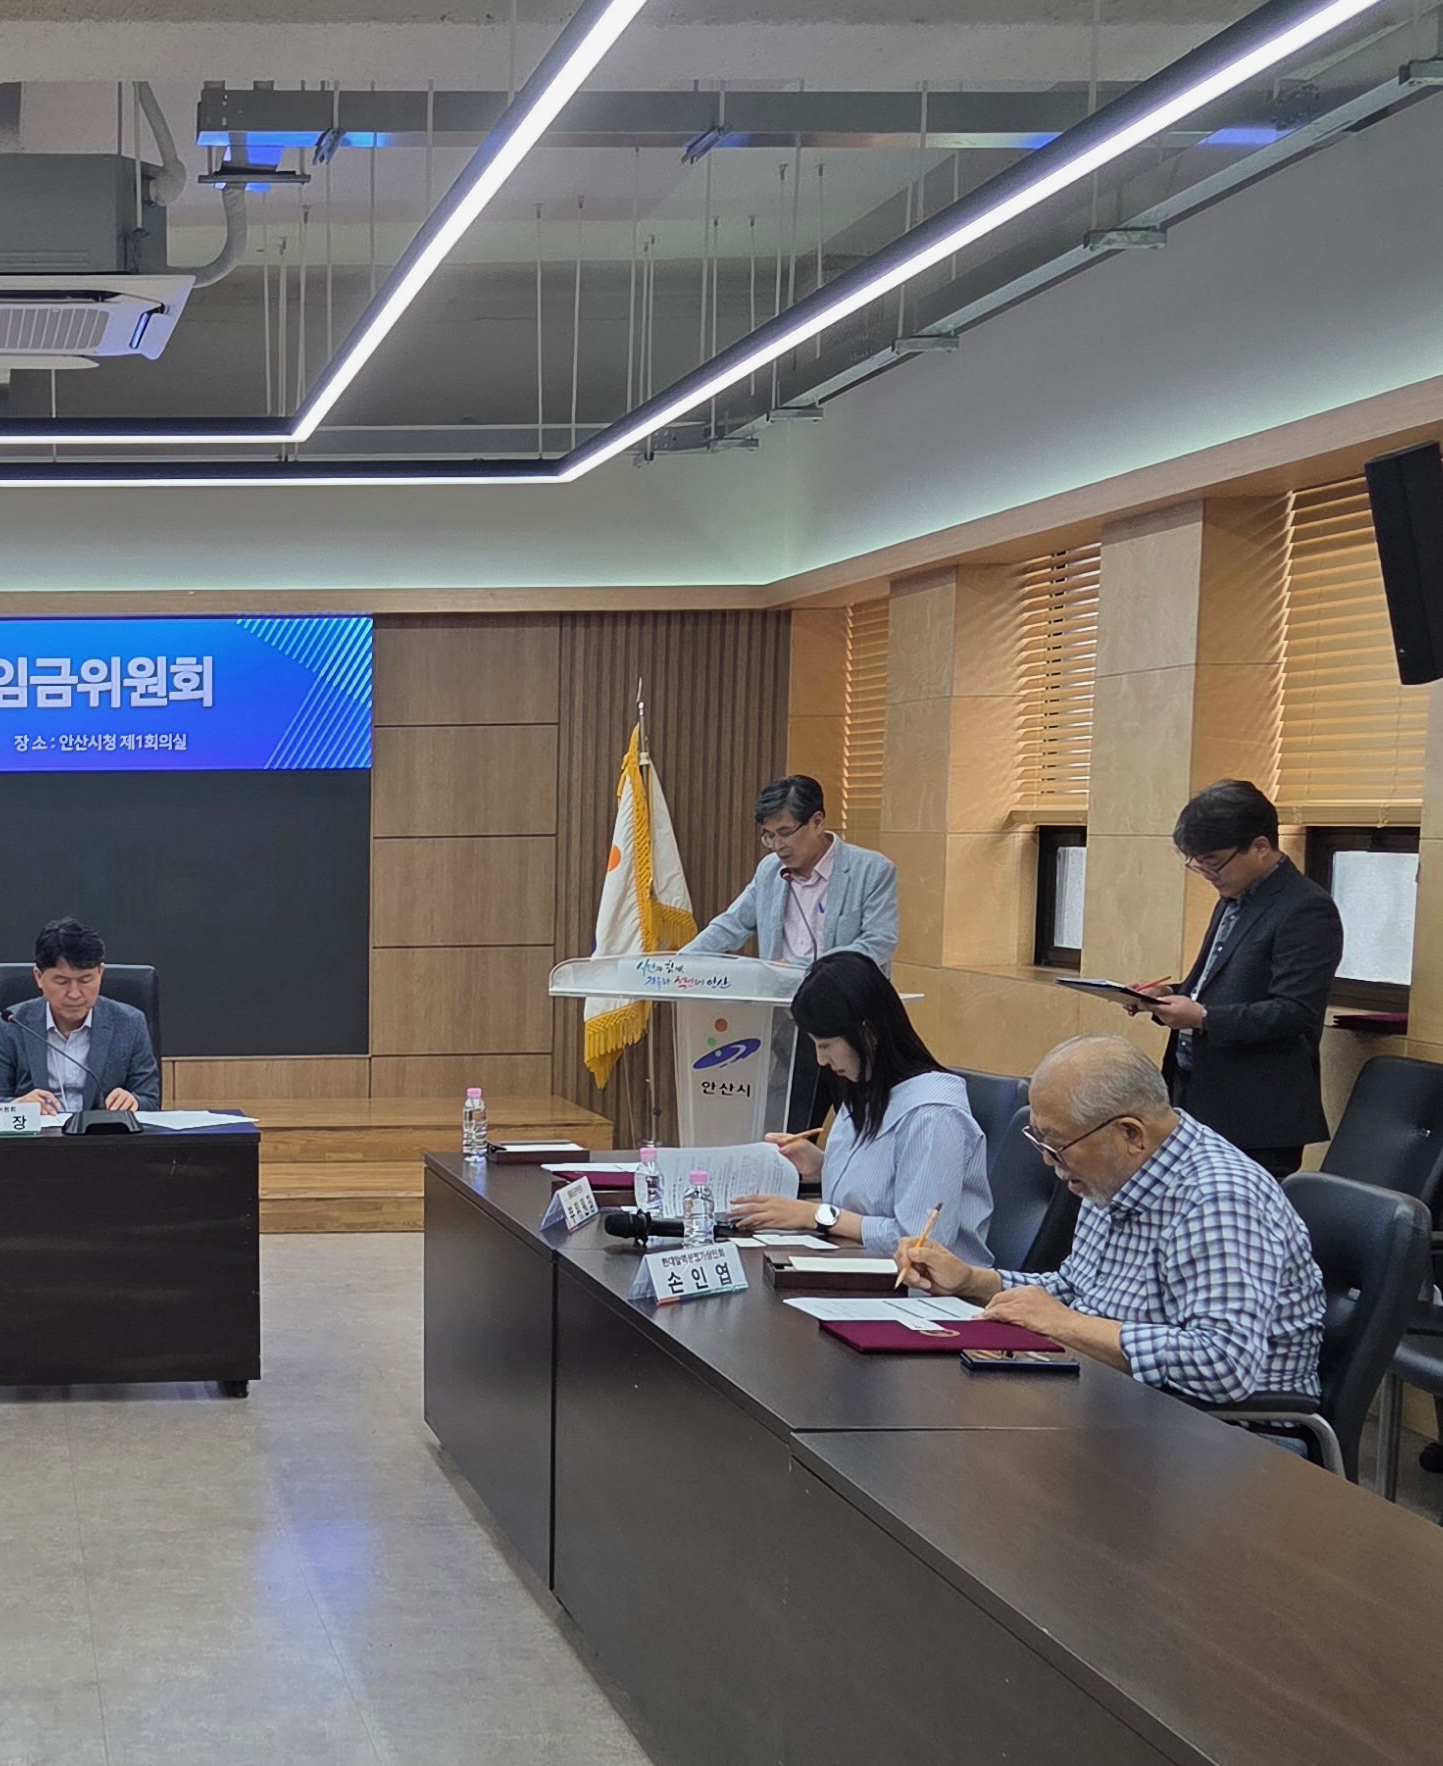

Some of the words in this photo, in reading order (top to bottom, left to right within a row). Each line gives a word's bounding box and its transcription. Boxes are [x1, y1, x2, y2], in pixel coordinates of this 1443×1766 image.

[58, 733, 117, 752] 안산시청
[119, 733, 188, 751] 제1회의실
[706, 976, 732, 989] 안산
[701, 1080, 751, 1098] 안산시
